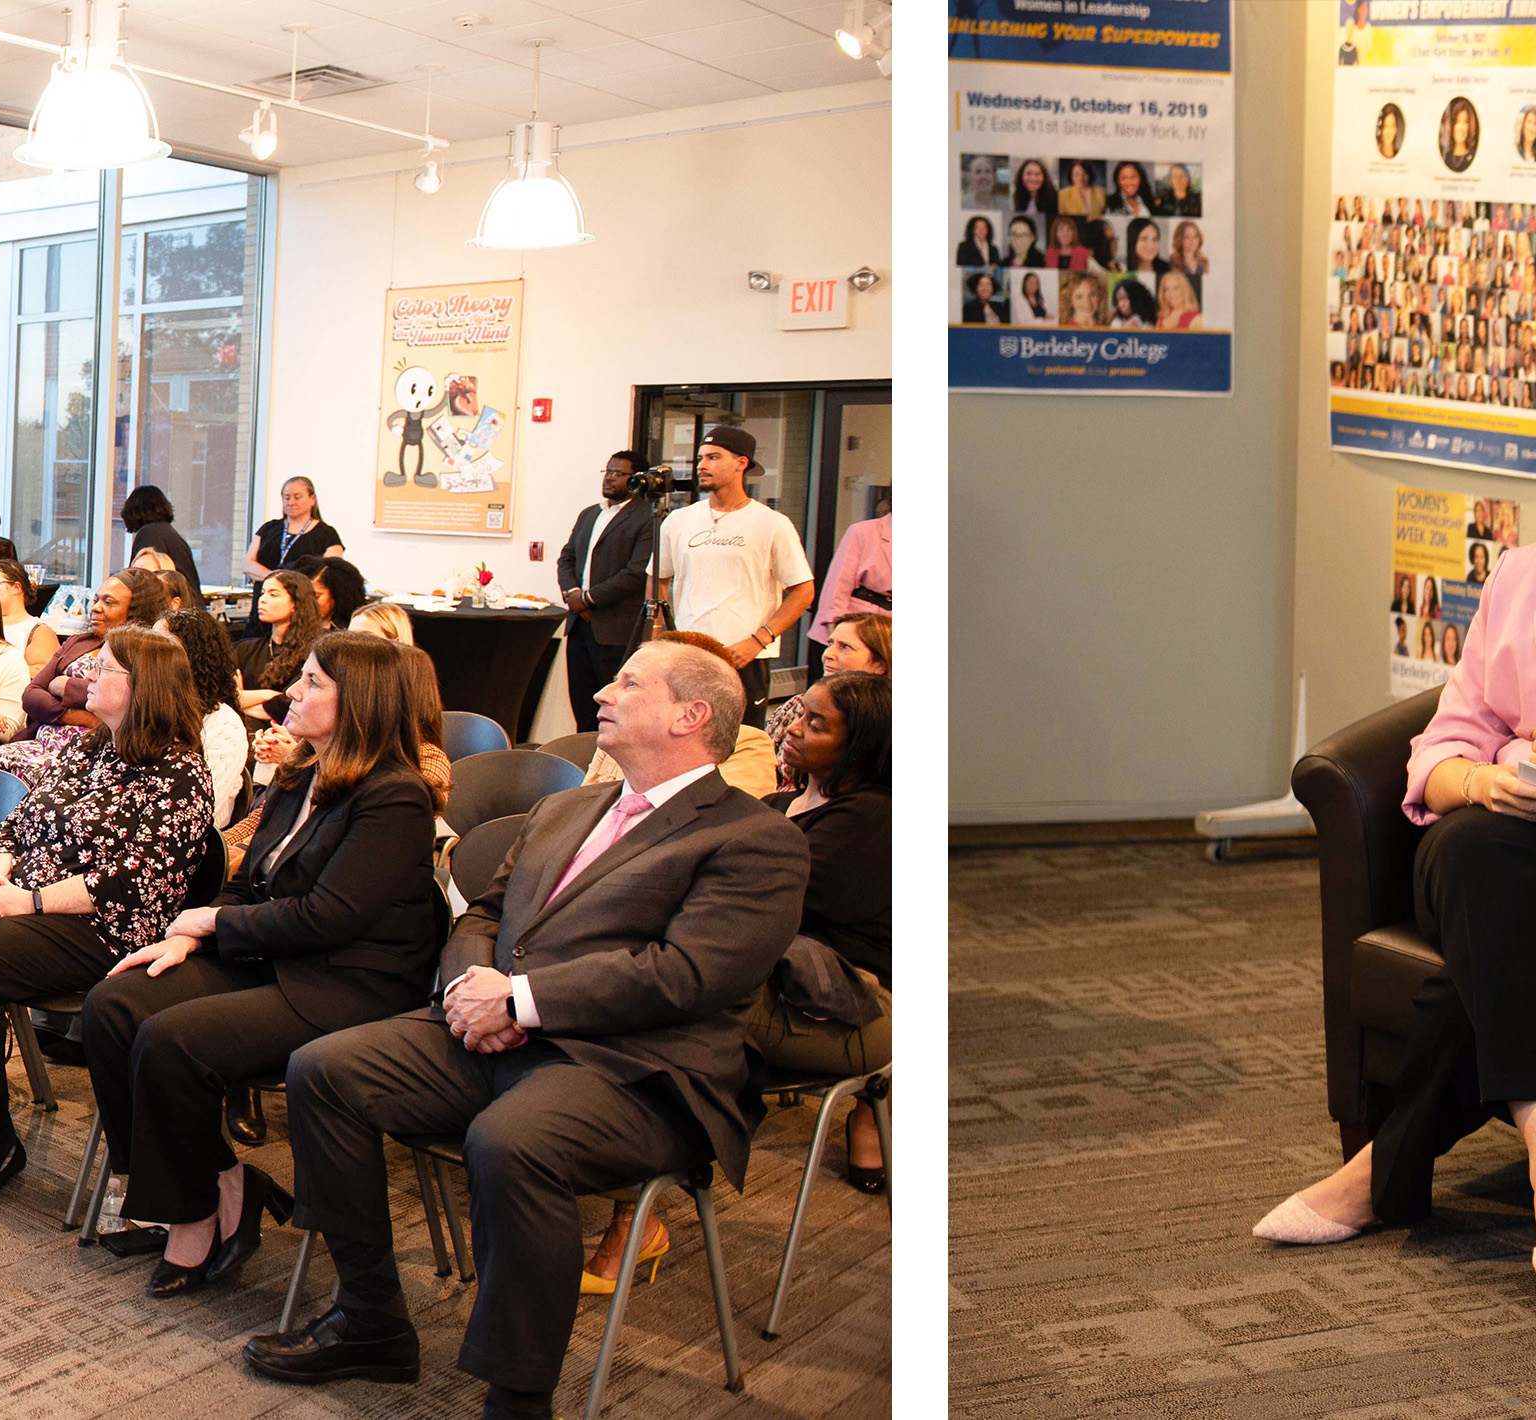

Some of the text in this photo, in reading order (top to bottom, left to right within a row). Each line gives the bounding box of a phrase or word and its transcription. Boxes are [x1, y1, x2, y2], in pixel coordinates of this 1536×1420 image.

[1080, 2, 1151, 19] Leadership
[967, 92, 1208, 118] Wednesday, October 16, 2019
[968, 116, 987, 131] 12
[991, 117, 1022, 133] East
[1027, 118, 1058, 134] 41st
[1115, 123, 1146, 137] New
[1150, 124, 1184, 140] York,
[1188, 126, 1208, 139] NY
[395, 294, 513, 318] Color Theory
[791, 280, 837, 313] EXIT
[409, 328, 463, 343] Human
[466, 325, 511, 341] Mind
[1020, 336, 1168, 364] Berkeley College
[1397, 492, 1449, 514] WOMEN'S
[1396, 526, 1426, 545] WEEK
